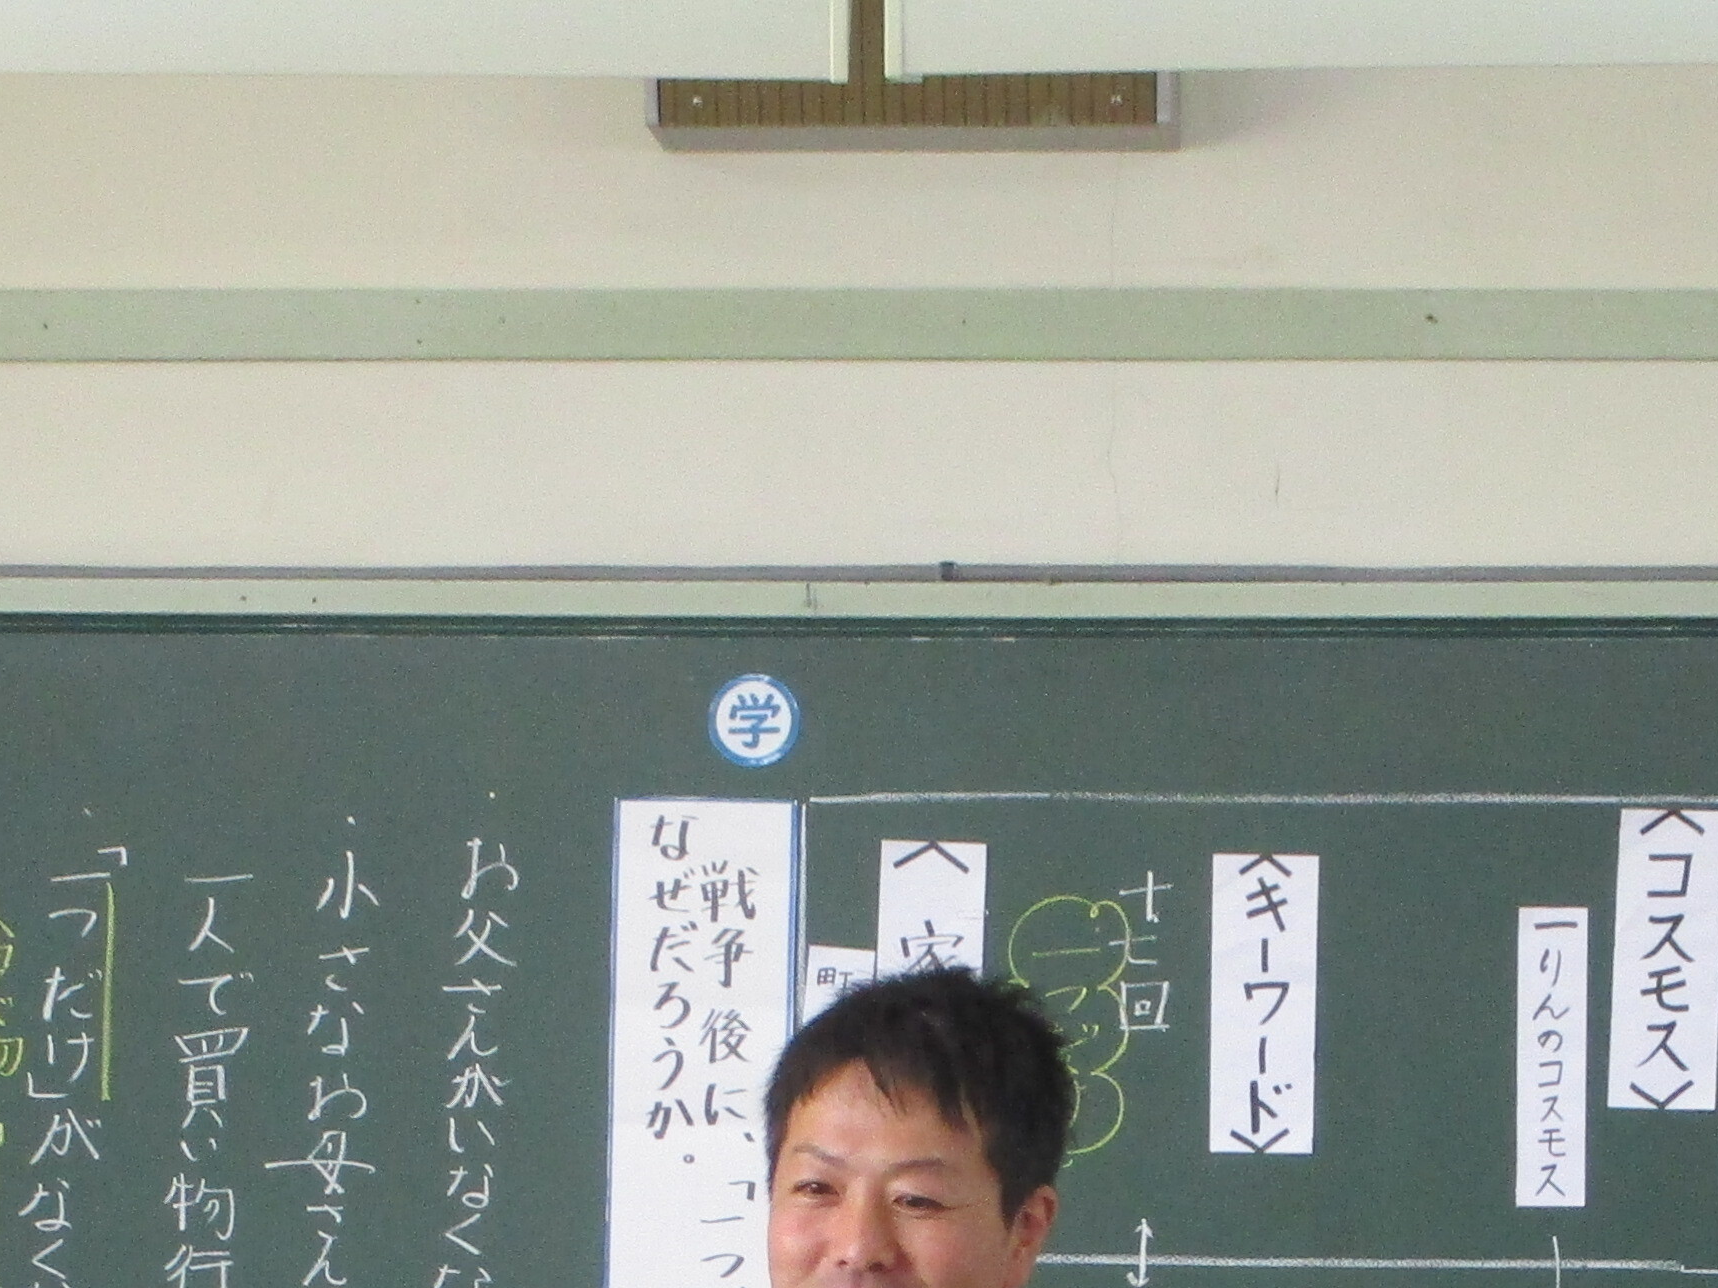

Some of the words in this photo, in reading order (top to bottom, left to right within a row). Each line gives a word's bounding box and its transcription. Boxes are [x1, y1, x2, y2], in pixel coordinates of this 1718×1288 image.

[727, 692, 781, 749] 学
[1531, 920, 1579, 1199] 一りんのコスモス
